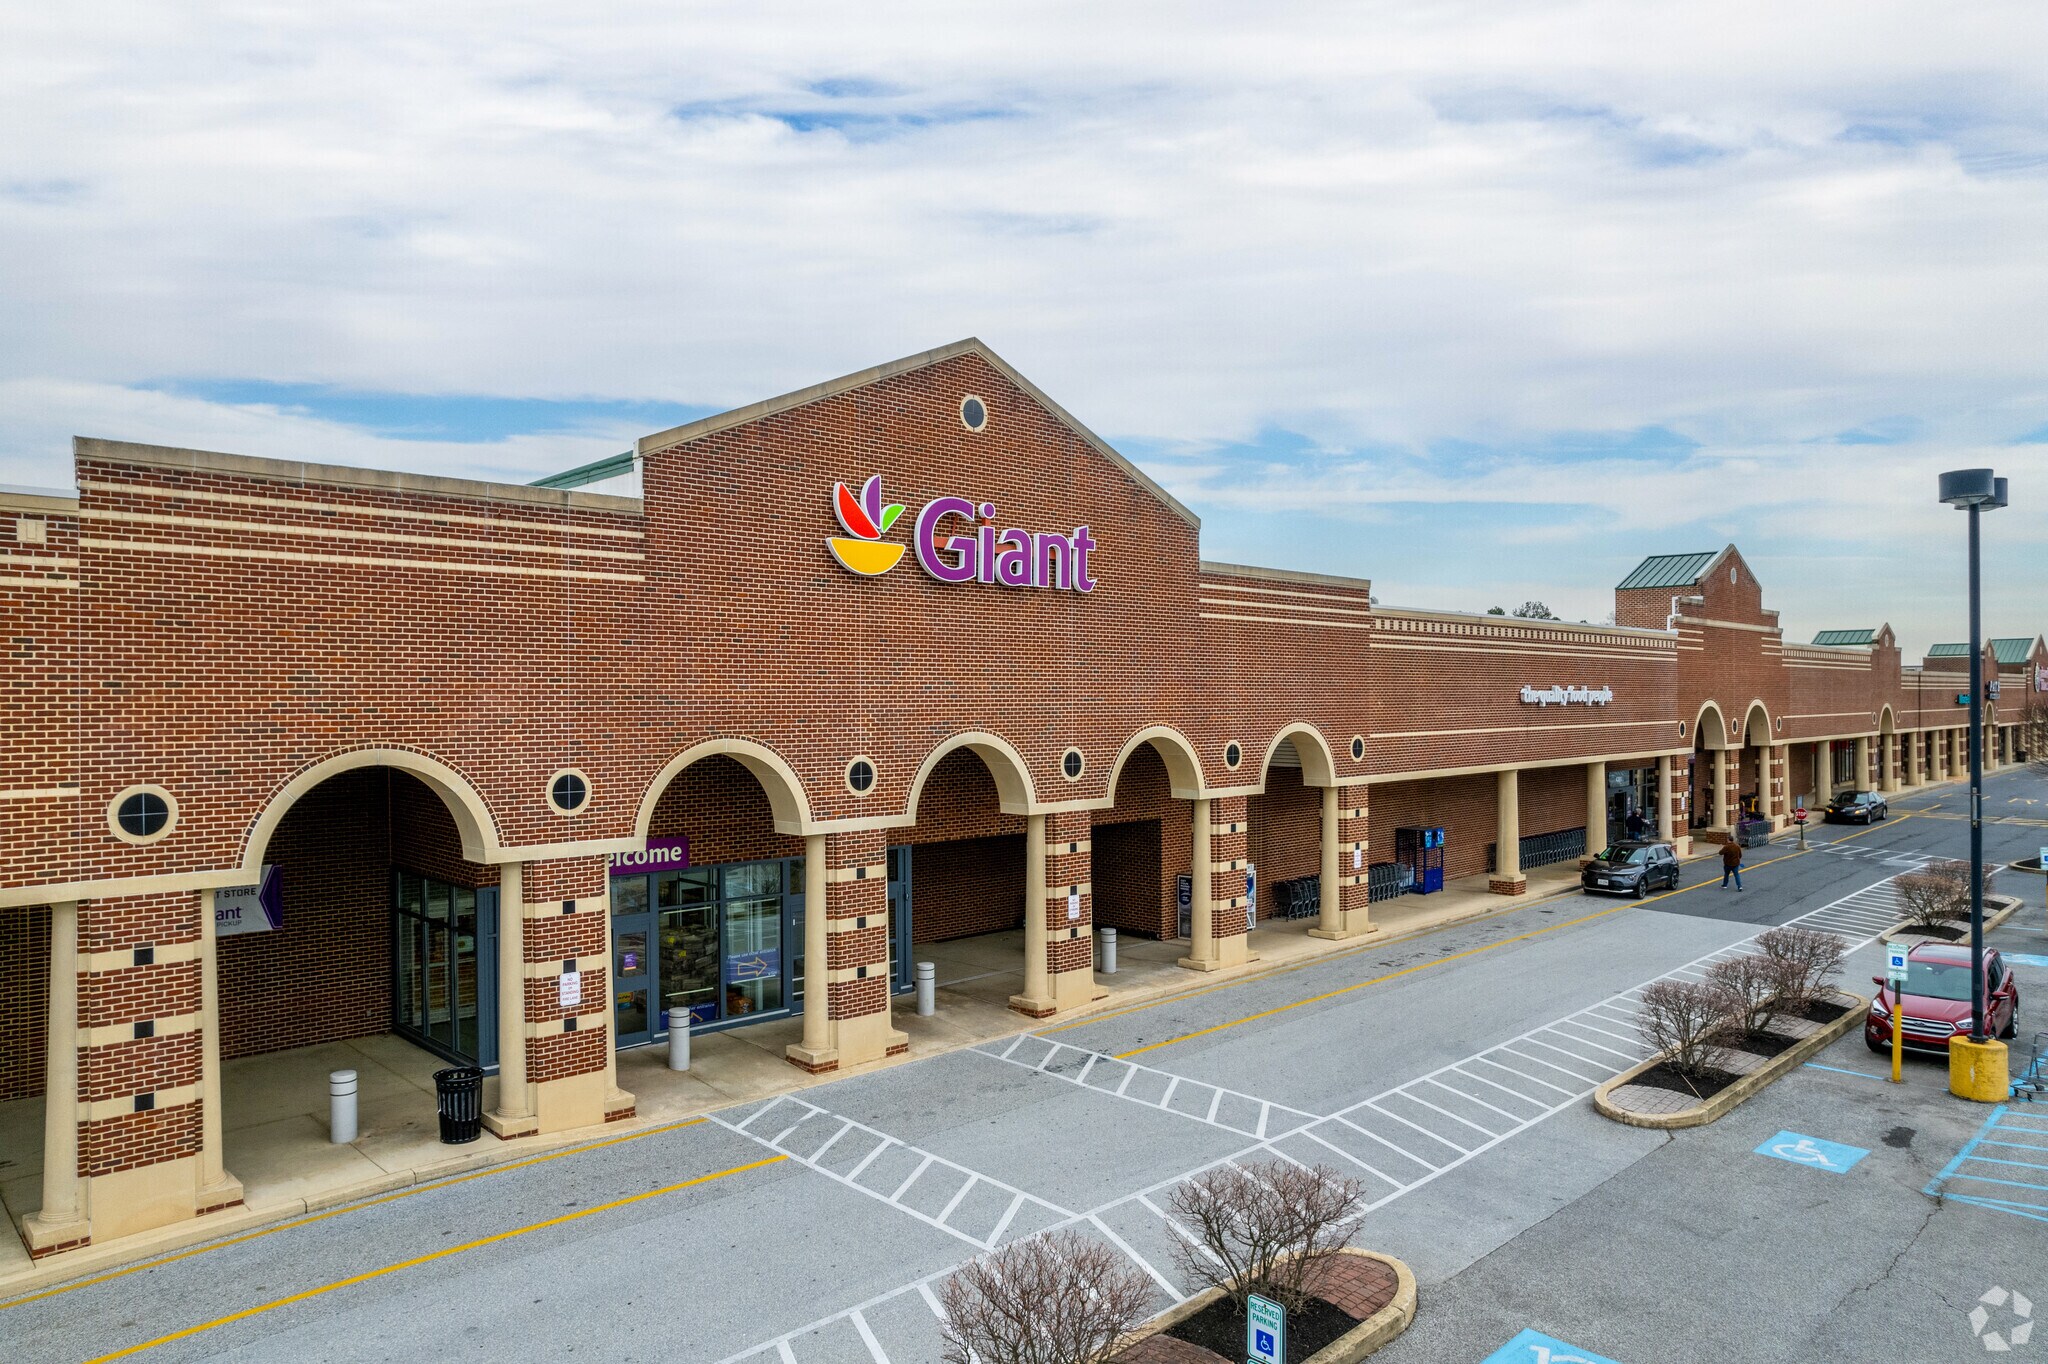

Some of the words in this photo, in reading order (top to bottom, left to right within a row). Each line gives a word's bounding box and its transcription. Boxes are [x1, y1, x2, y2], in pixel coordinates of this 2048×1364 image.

[914, 496, 1098, 593] Giant
[1520, 685, 1539, 702] the
[1539, 685, 1568, 706] quality
[1567, 685, 1586, 702] food
[1586, 685, 1613, 706] people
[609, 846, 682, 868] elcome
[224, 888, 256, 898] STORE
[215, 906, 242, 921] ant
[216, 920, 242, 928] PICKUP
[1250, 1302, 1280, 1320] RESERVED
[1252, 1313, 1278, 1330] PARKING
